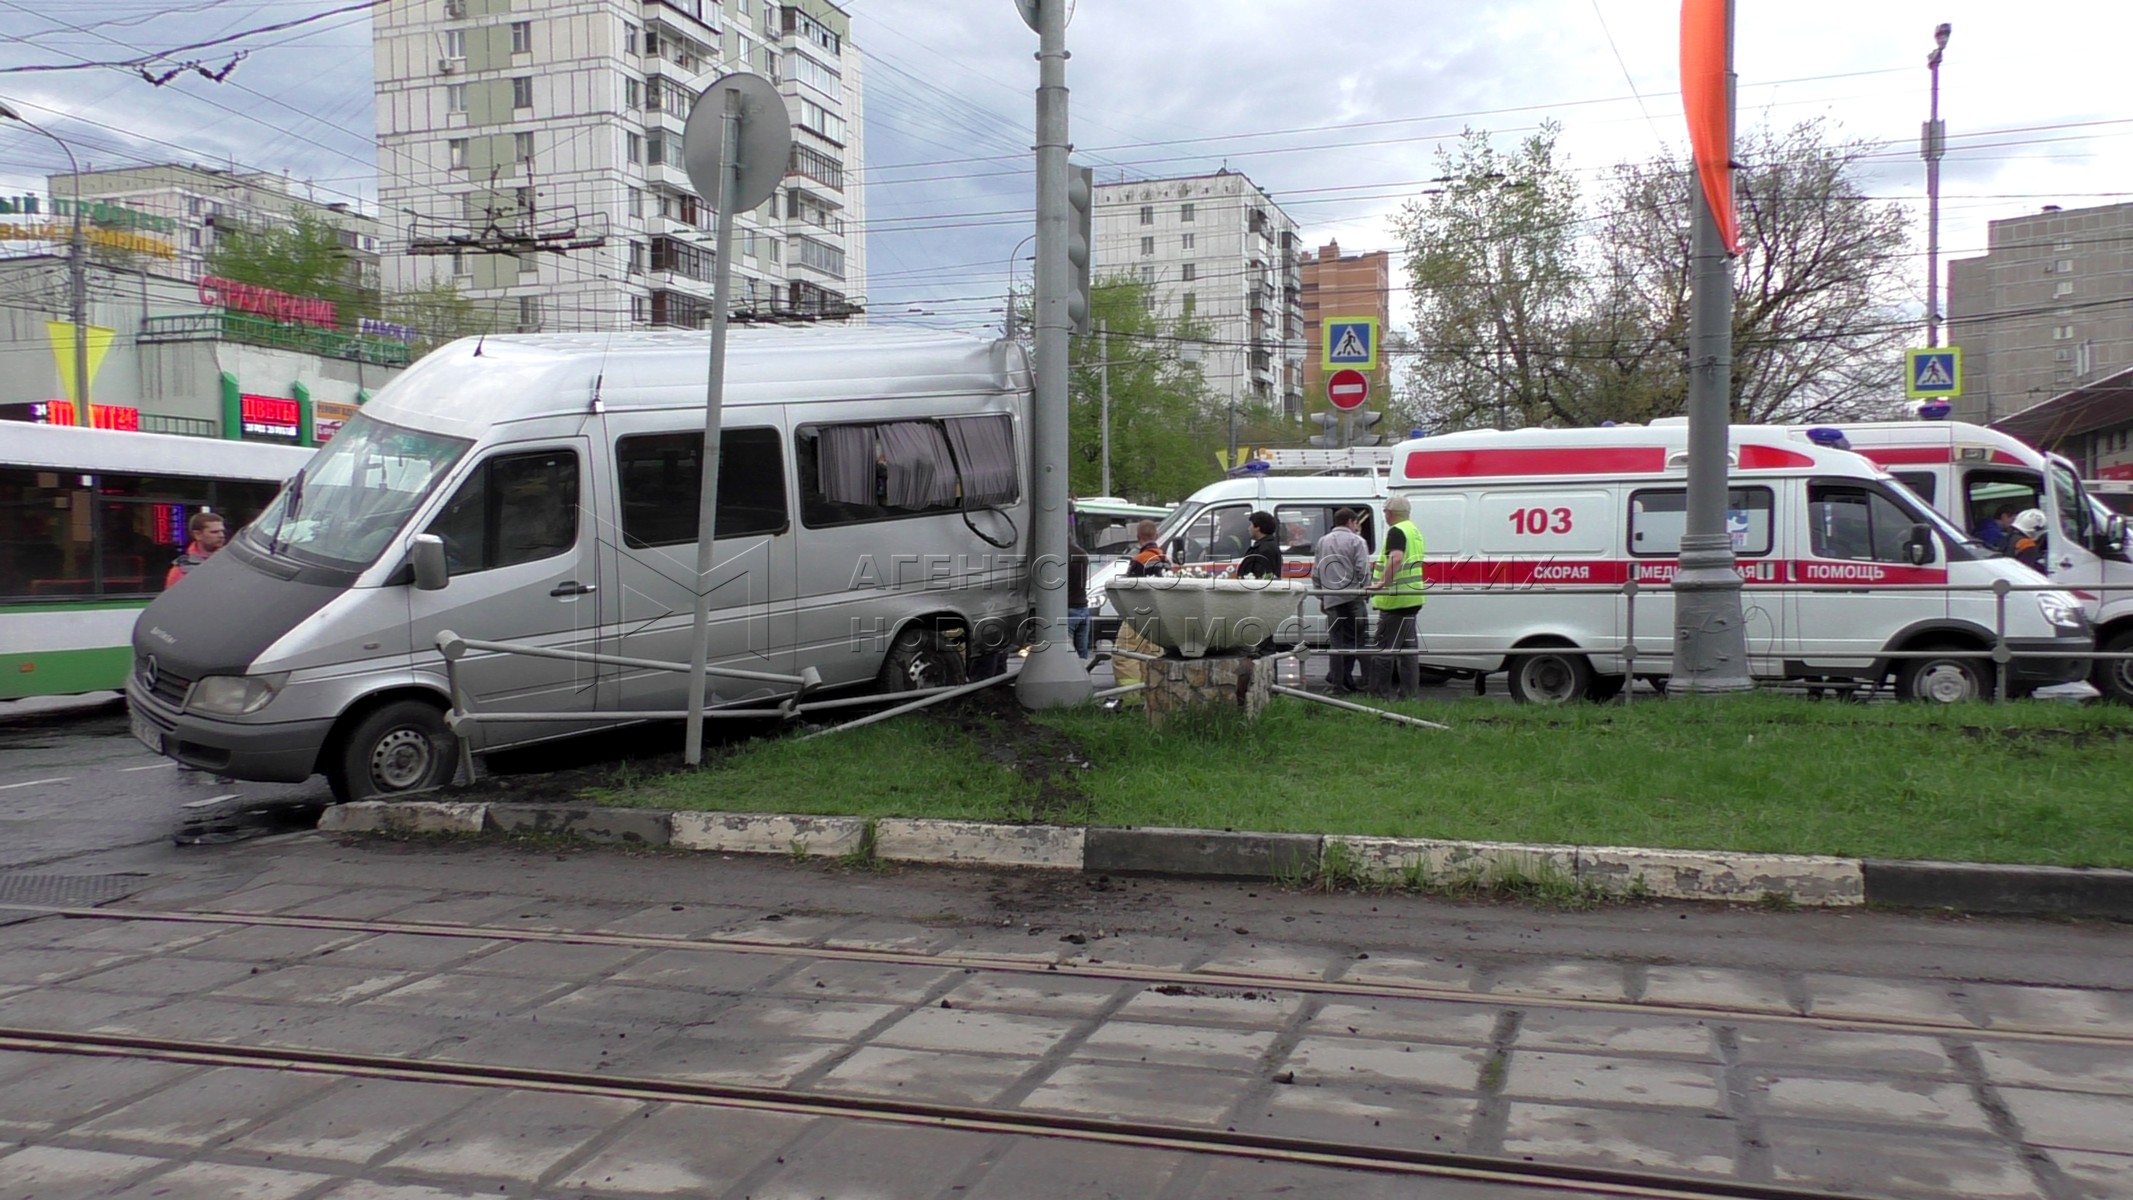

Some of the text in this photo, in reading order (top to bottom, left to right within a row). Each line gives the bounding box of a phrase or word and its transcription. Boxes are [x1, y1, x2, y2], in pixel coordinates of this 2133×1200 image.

[198, 275, 340, 331] СТРАХОВАНИЕ
[243, 398, 298, 422] ЦВЕТЫ
[1508, 507, 1573, 534] 103
[1534, 565, 1590, 579] СКОРАЯ
[1807, 565, 1885, 580] ПОМОЩЬ
